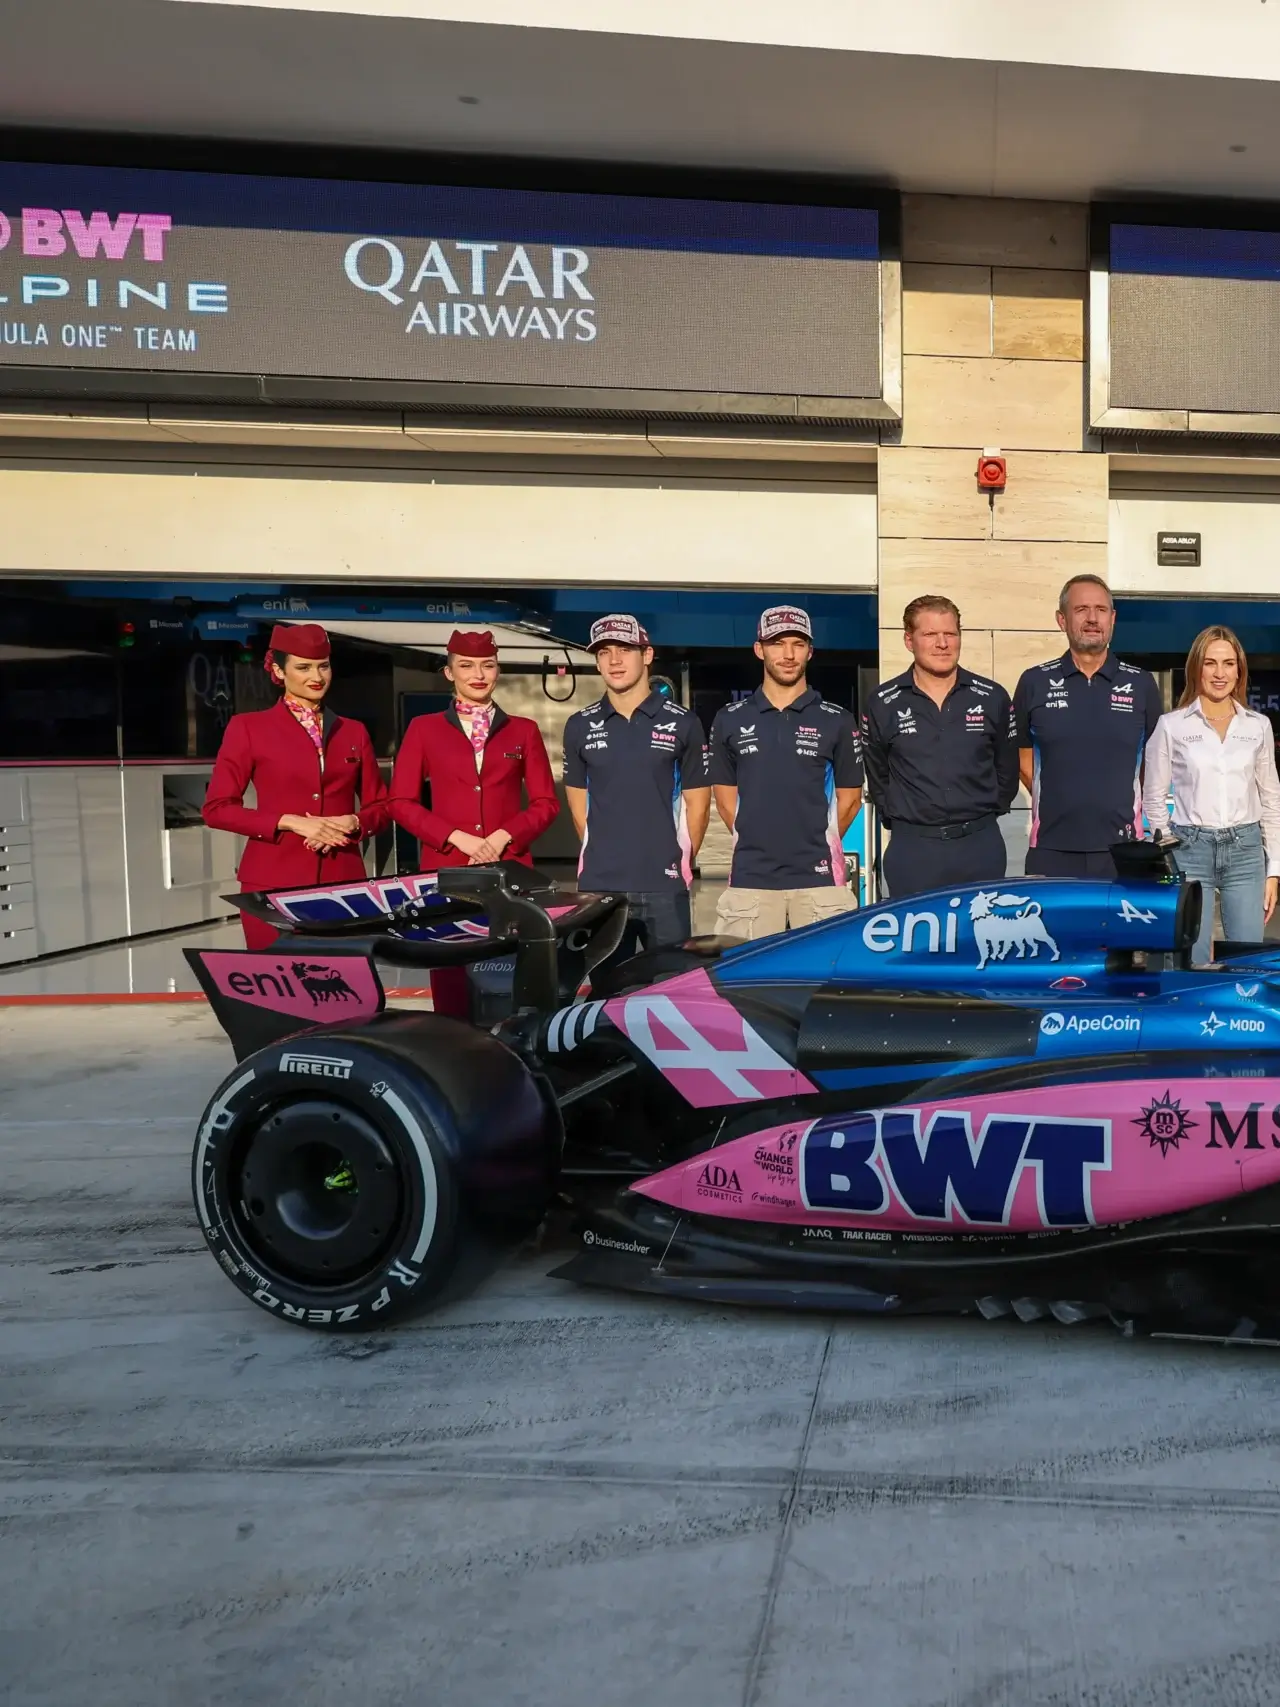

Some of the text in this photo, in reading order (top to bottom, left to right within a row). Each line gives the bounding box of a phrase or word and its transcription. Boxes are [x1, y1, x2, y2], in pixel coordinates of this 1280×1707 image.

[21, 208, 172, 261] BWT
[344, 238, 595, 306] QATAR
[405, 301, 598, 342] AIRWAYS
[133, 327, 197, 351] TEAM
[263, 600, 287, 612] eni
[427, 602, 450, 614] eni
[585, 742, 597, 750] eni
[862, 896, 962, 954] eni
[228, 965, 296, 998] eni
[1066, 1014, 1141, 1033] ApeCoin
[1229, 1018, 1266, 1033] MODO
[278, 1052, 354, 1080] PIRELLI
[754, 1150, 793, 1166] CHANGE
[800, 1107, 1113, 1228] BWT
[697, 1163, 743, 1192] ADA
[761, 1162, 794, 1175] WORLD
[697, 1187, 743, 1204] COSMETICS
[595, 1234, 650, 1254] businessolver
[842, 1230, 892, 1241] TRAK RACER
[902, 1233, 954, 1242] MISSION
[251, 1287, 361, 1324] ZERO
